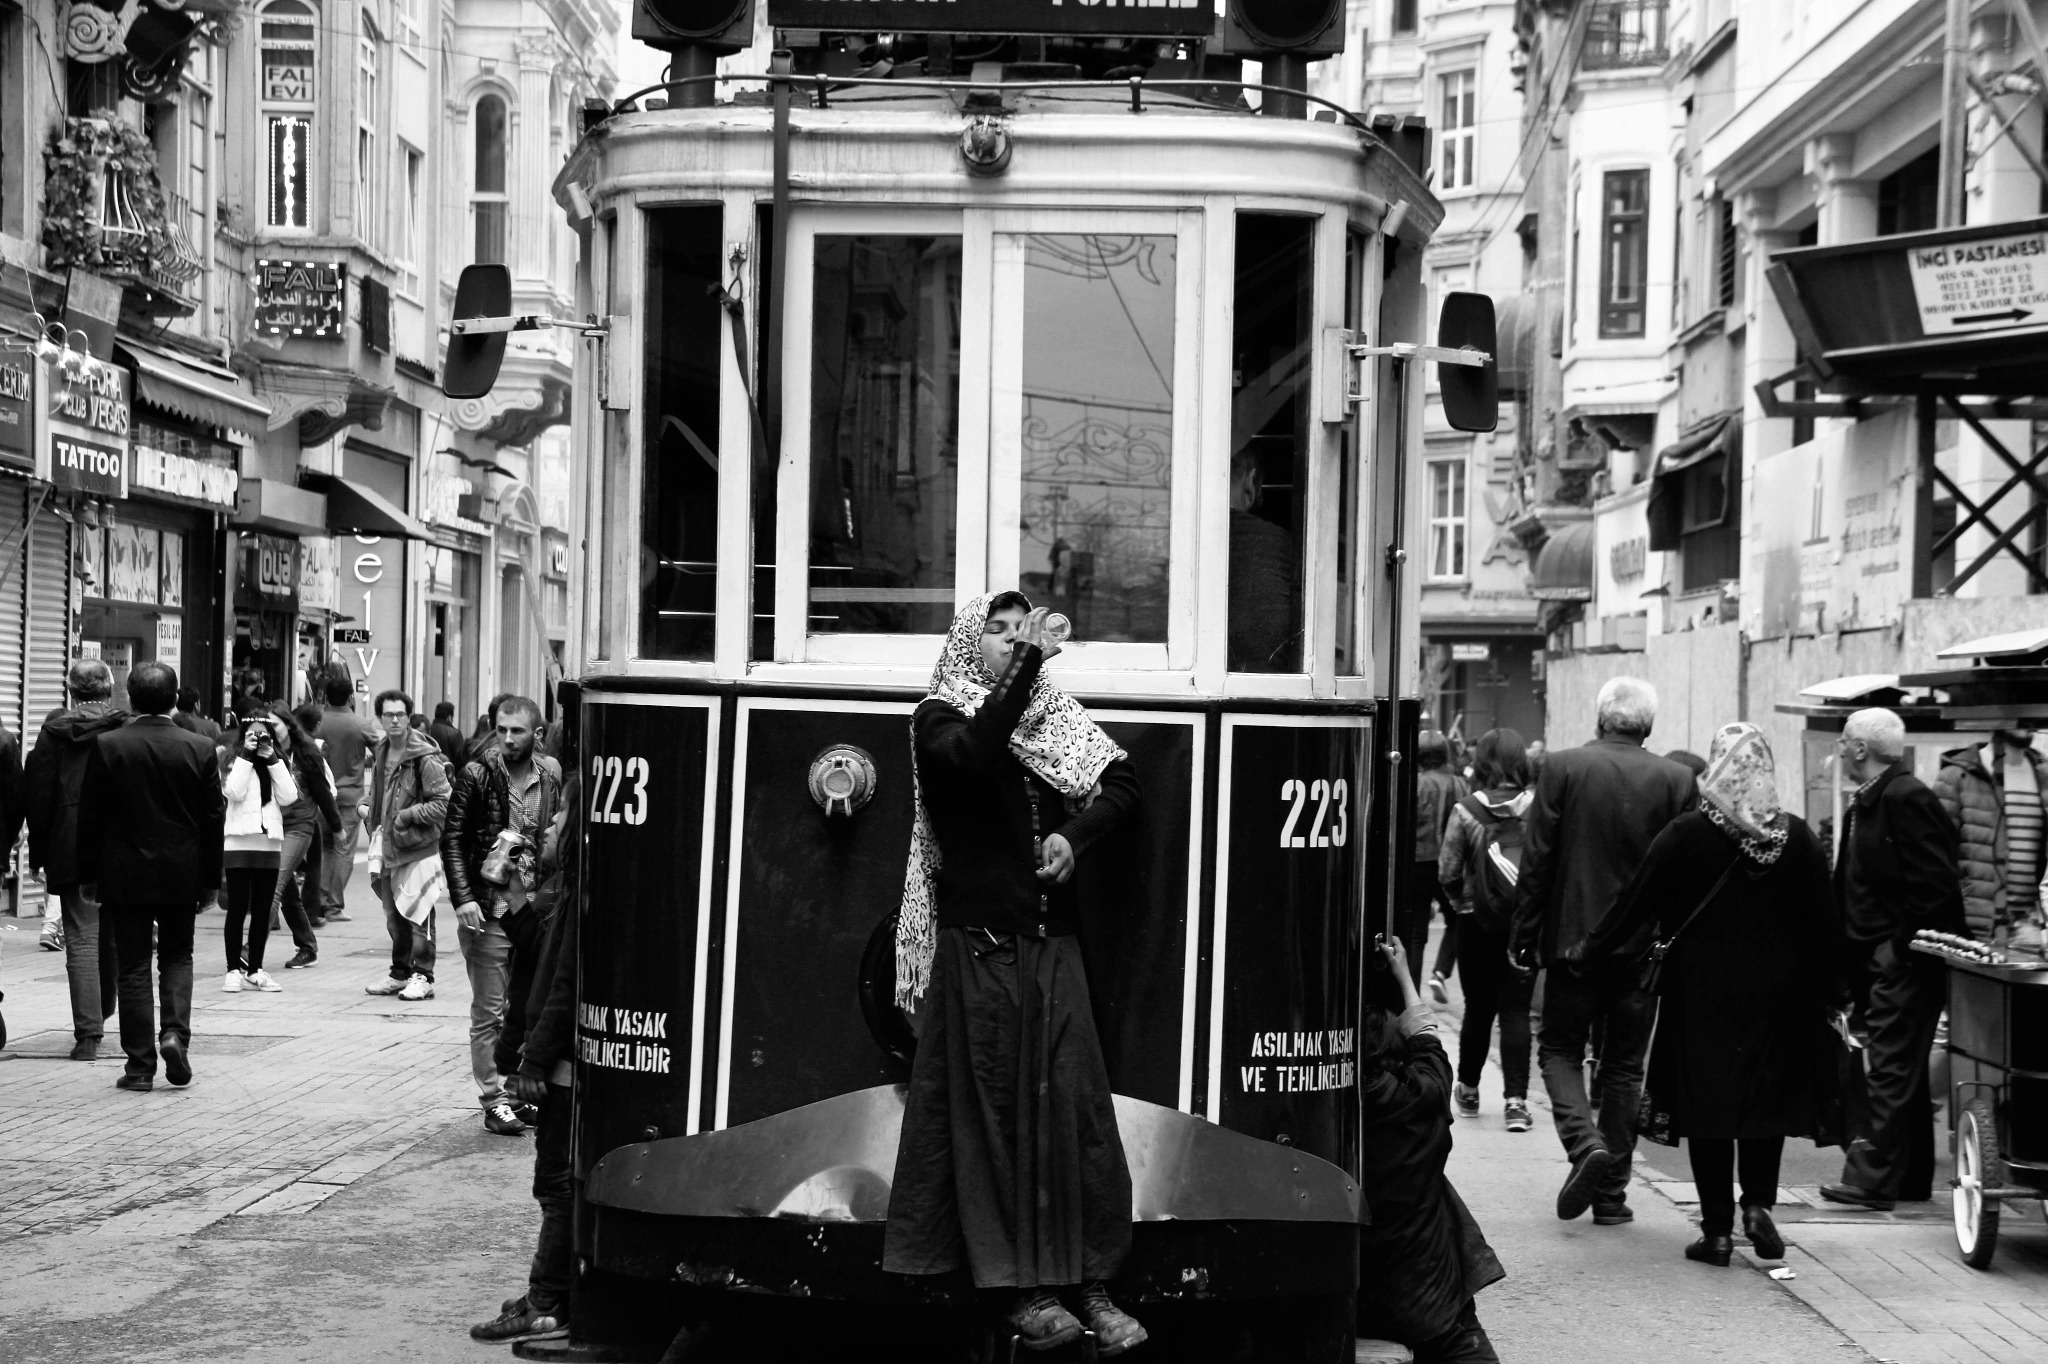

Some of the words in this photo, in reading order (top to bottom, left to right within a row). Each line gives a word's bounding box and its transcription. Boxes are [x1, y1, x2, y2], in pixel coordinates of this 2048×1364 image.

[268, 67, 312, 82] FAL
[271, 83, 306, 99] EVİ
[1916, 246, 1948, 269] İNCİ
[1954, 233, 2046, 265] PASTANESİ
[264, 265, 337, 291] FAL
[66, 394, 86, 419] CLUB
[90, 395, 128, 435] VEGAS
[57, 441, 120, 478] TATTOO
[134, 445, 166, 491] THE
[165, 453, 204, 499] BODY
[207, 464, 238, 506] SHOP
[344, 630, 368, 642] FAL
[591, 756, 649, 826] 223
[1280, 779, 1348, 848] 223
[614, 1008, 668, 1039] YASAK
[582, 1035, 671, 1074] TEHLİKELİDİR
[1251, 1031, 1323, 1057] ASILMAK
[1327, 1027, 1354, 1055] YASAK
[1241, 1066, 1267, 1092] VE
[1276, 1058, 1354, 1092] TEHLİKELİDİR
